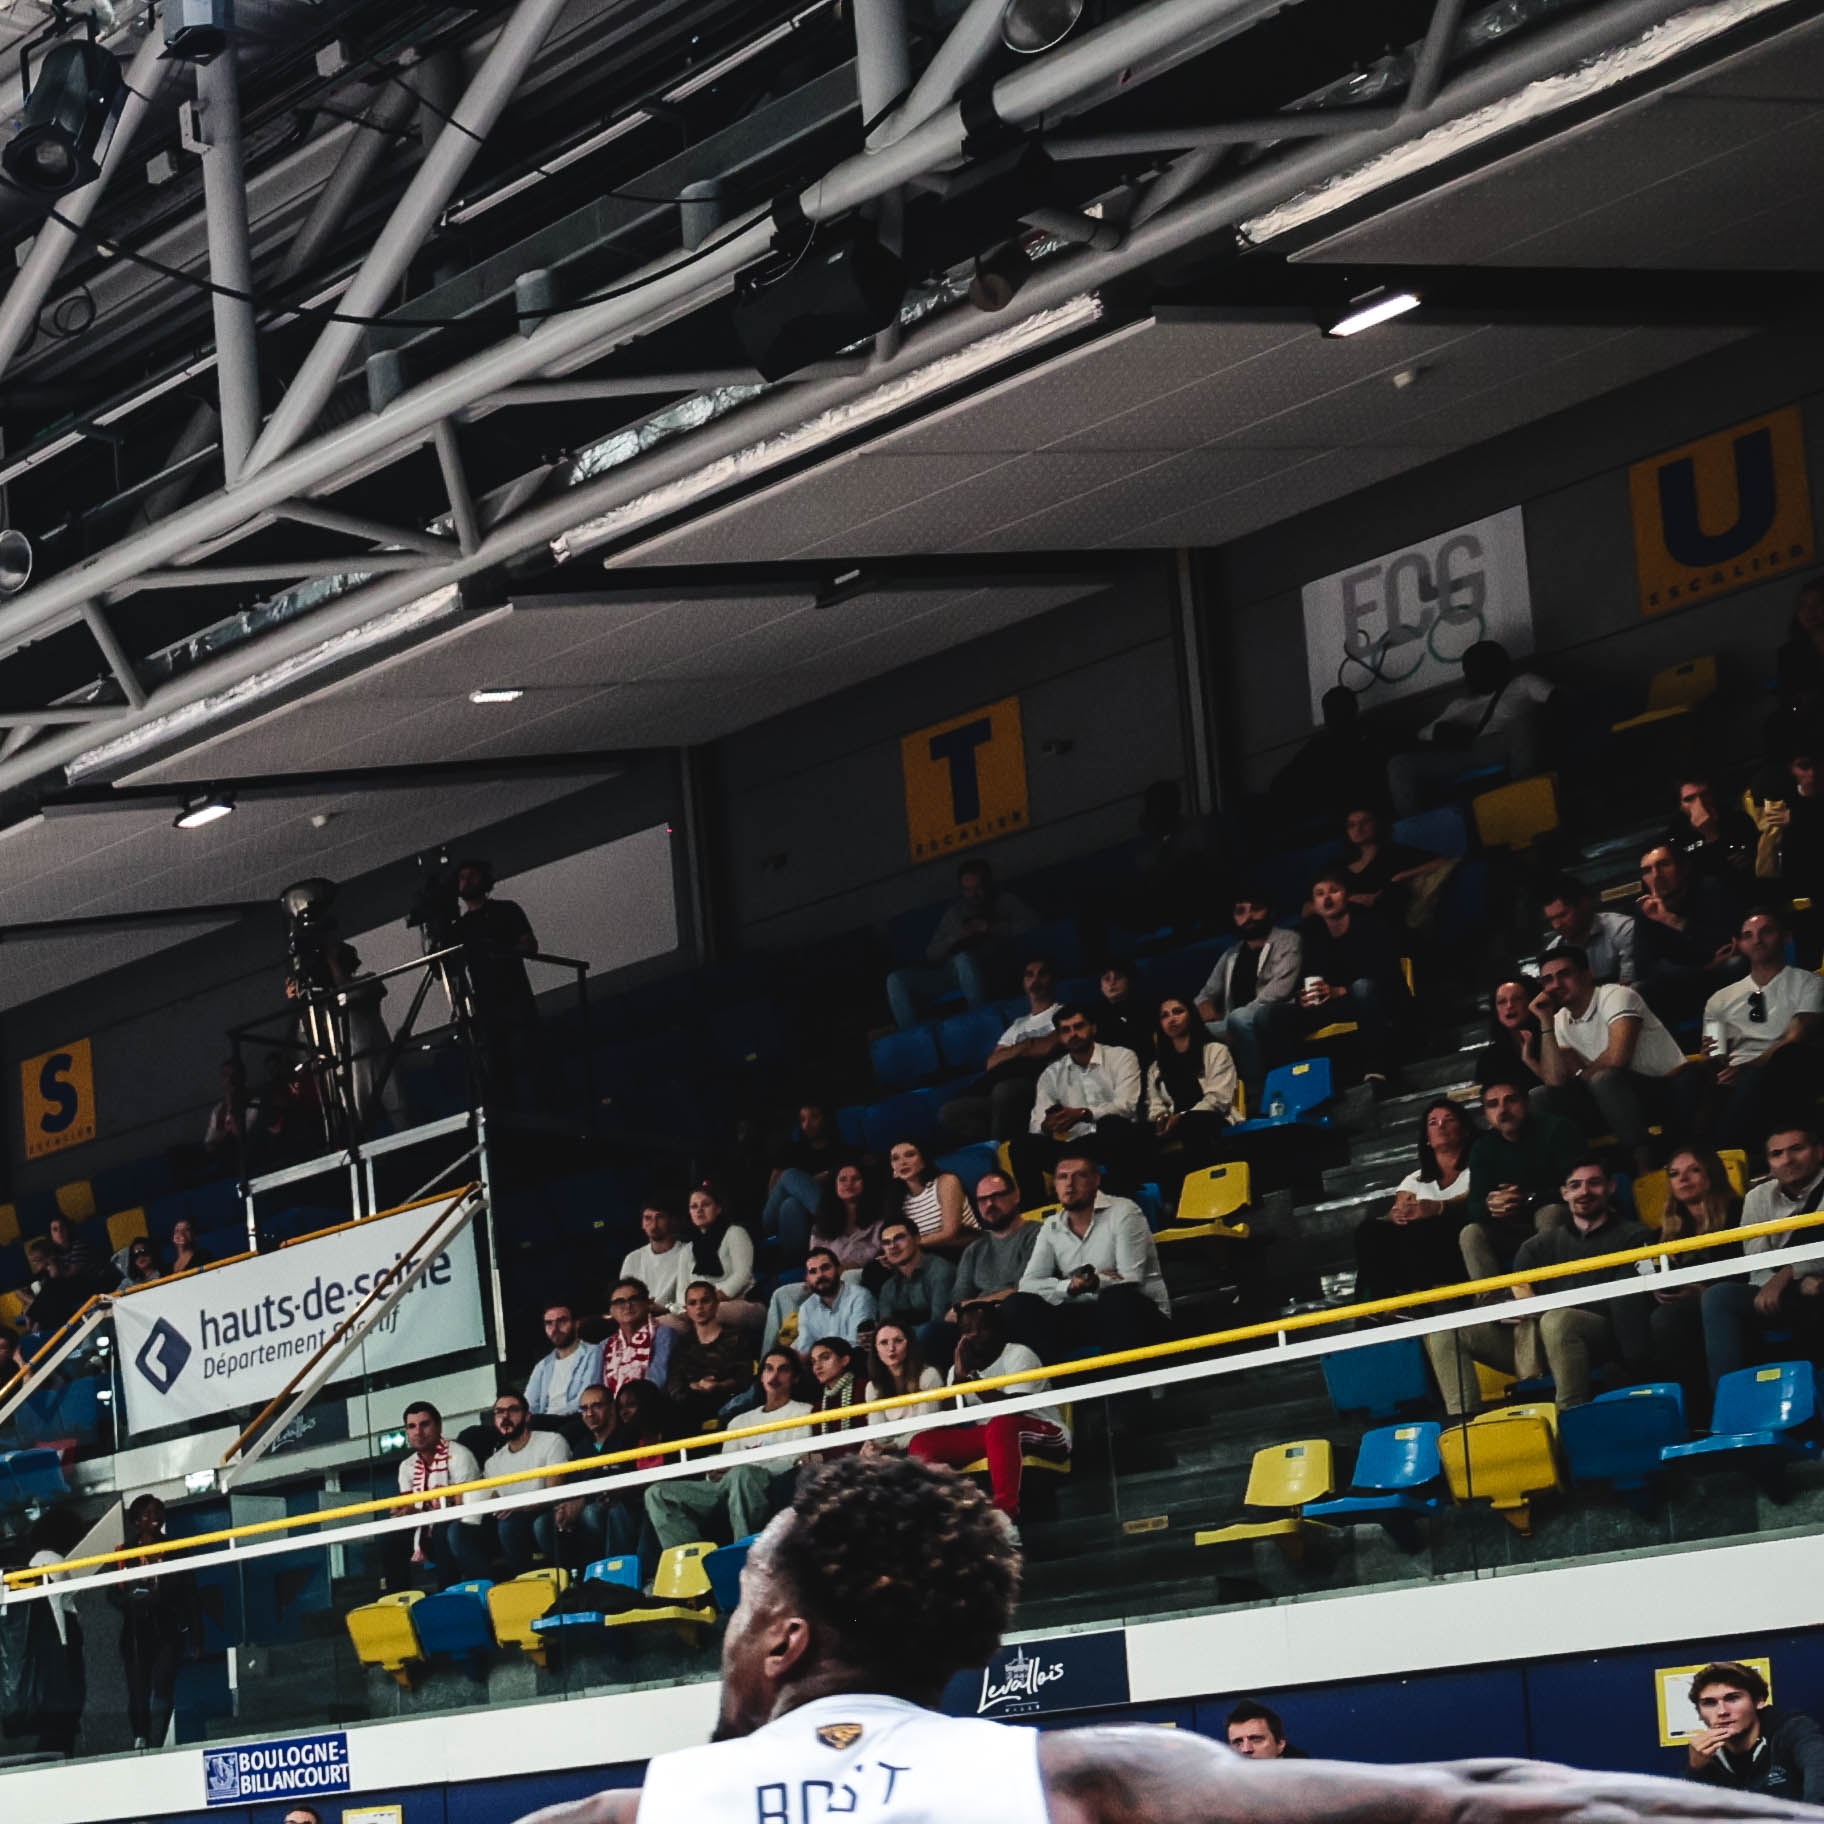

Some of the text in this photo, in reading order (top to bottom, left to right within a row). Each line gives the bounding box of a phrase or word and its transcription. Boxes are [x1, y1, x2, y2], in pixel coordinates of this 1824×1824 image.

[1658, 427, 1775, 567] U
[1648, 545, 1803, 606] ESCALIER
[929, 717, 991, 824] T
[40, 1053, 78, 1132] S
[204, 1328, 325, 1379] Département
[977, 1657, 1065, 1714] Levallois
[238, 1738, 347, 1772] BOULOGNE-
[239, 1763, 350, 1796] BILLANCOURT
